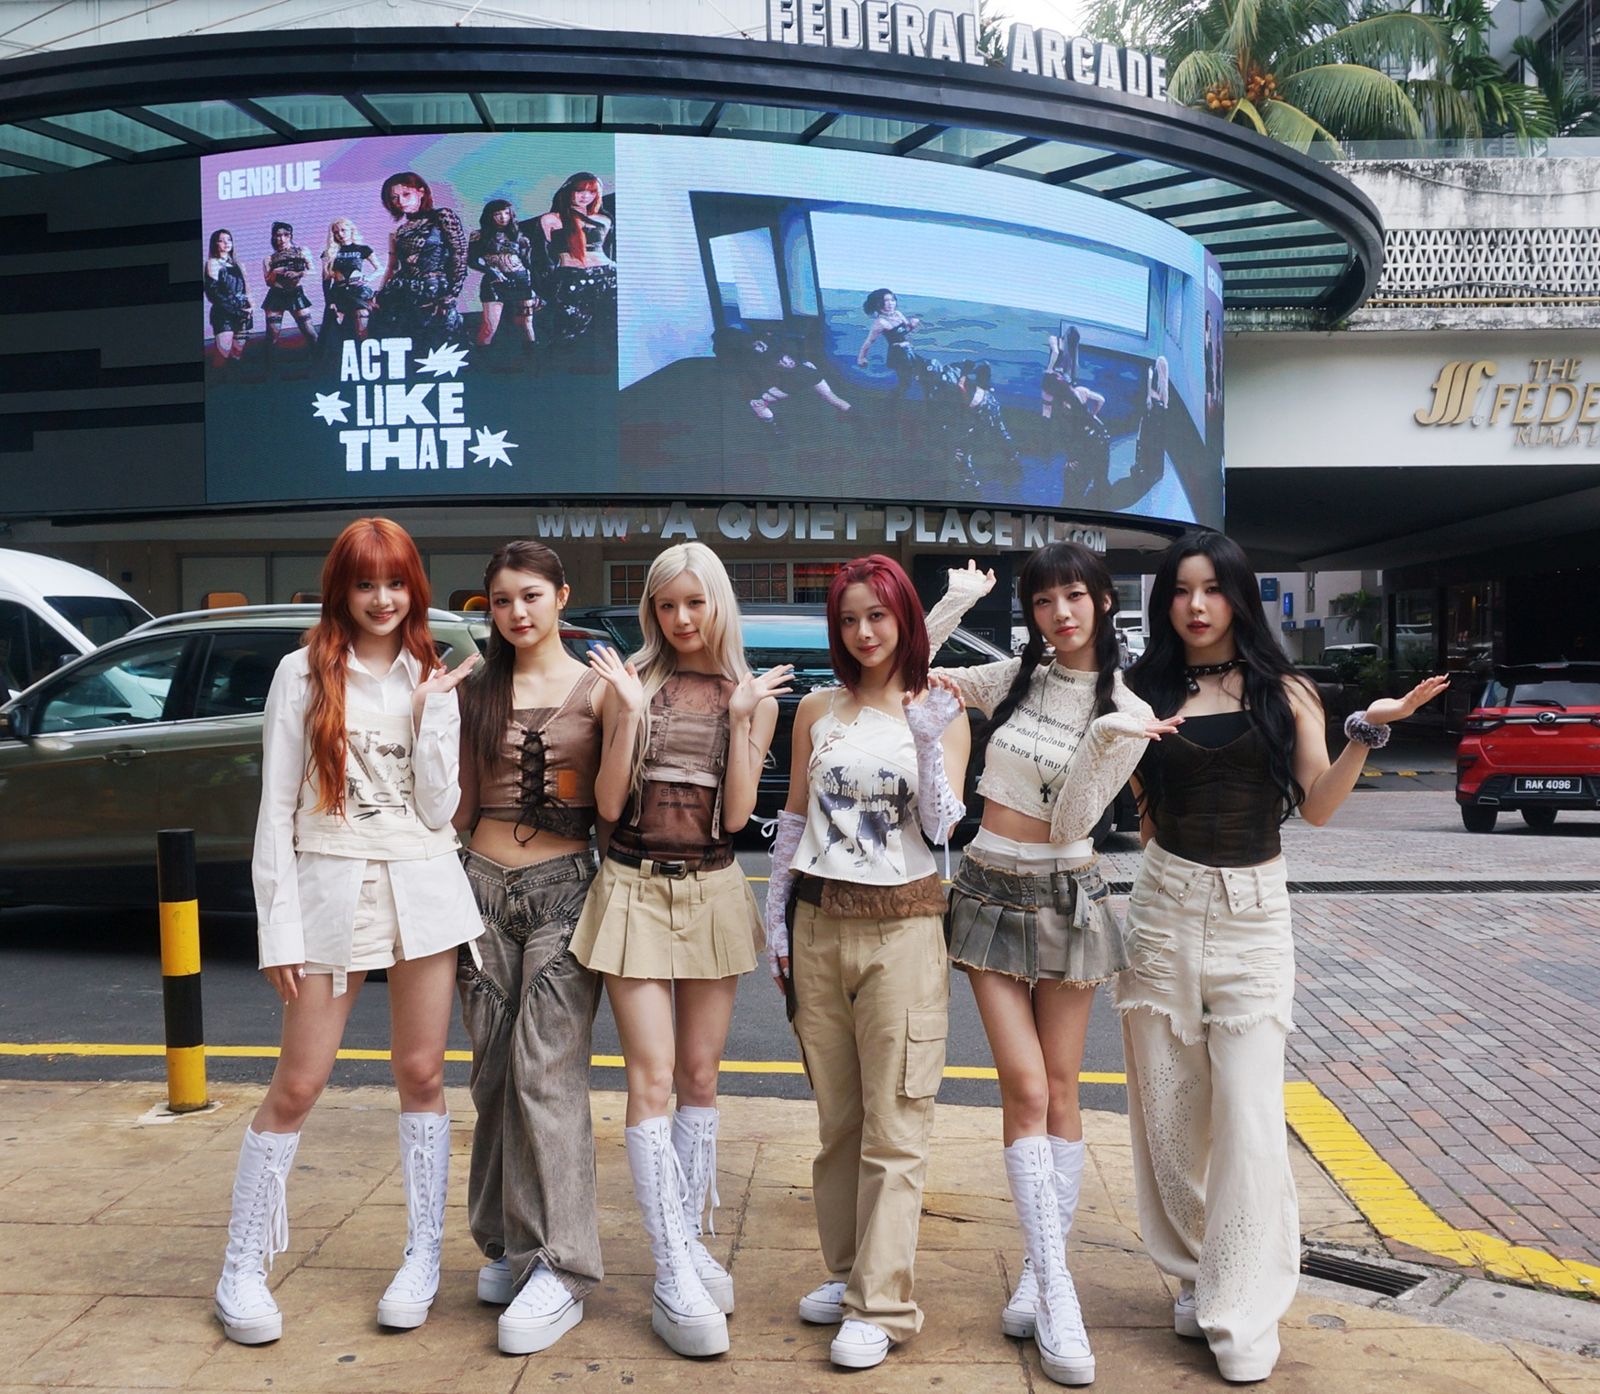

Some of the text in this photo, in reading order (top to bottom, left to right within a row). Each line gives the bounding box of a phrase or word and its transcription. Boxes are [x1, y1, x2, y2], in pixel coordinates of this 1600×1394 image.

[767, 0, 1168, 101] FEDERAL ARCADE
[218, 160, 321, 200] GENBLUE
[340, 337, 413, 382] ACT
[1531, 358, 1583, 383] THE
[356, 382, 465, 426] LIKE
[339, 427, 472, 472] THAT
[660, 501, 698, 539] A
[717, 502, 860, 541] QUIET
[885, 507, 1015, 546] PLACE
[1023, 513, 1062, 549] KL
[1525, 779, 1571, 790] RAK 4096
